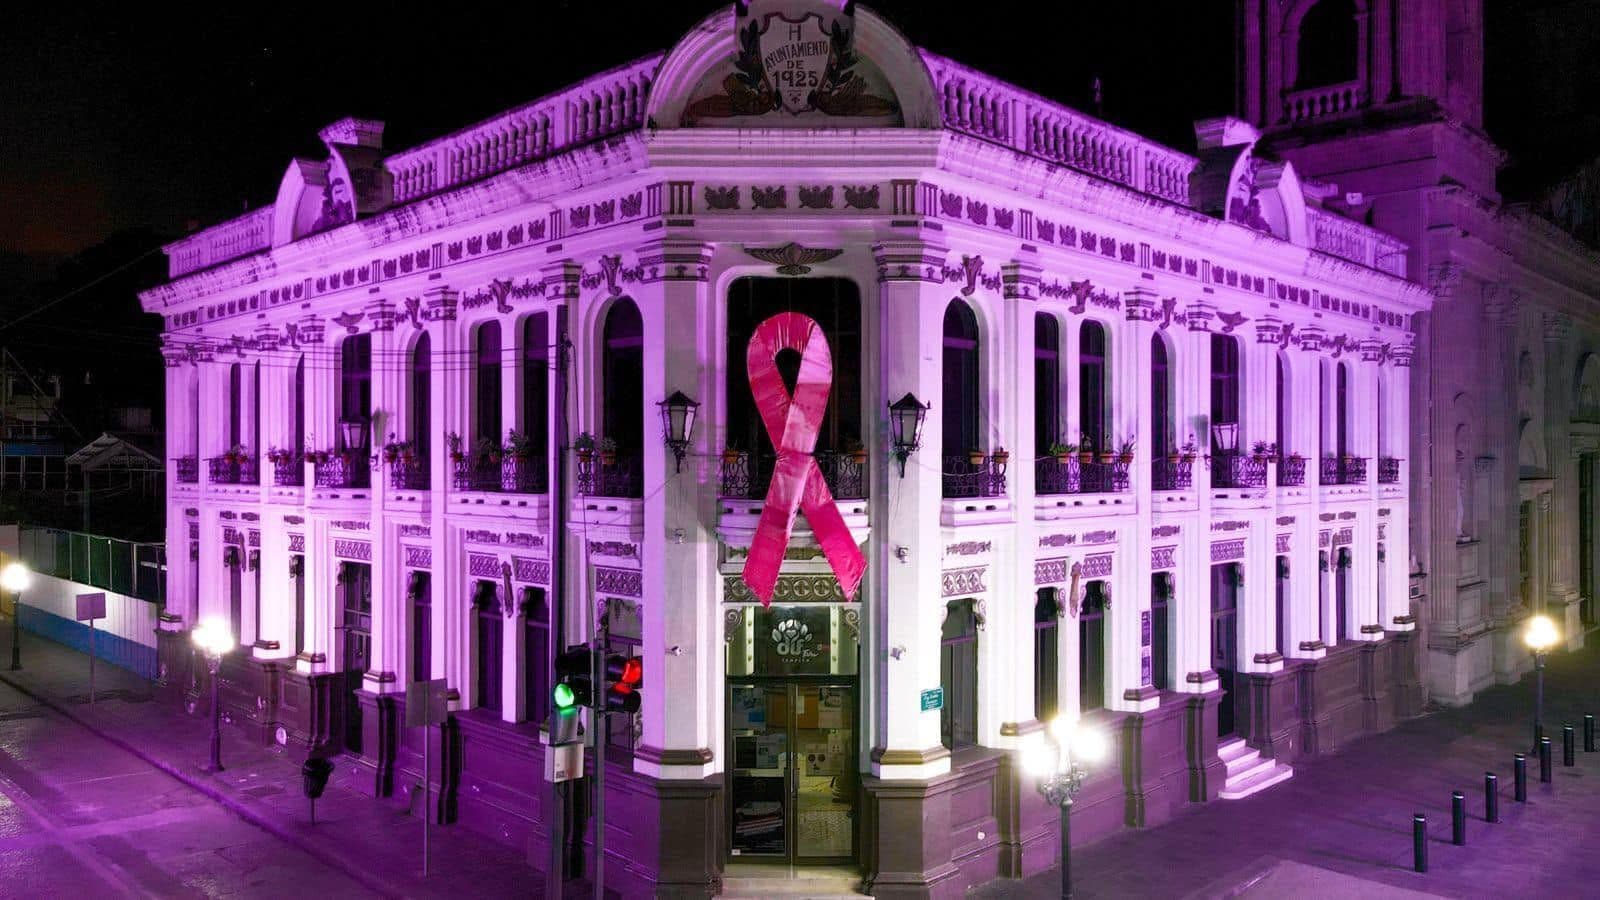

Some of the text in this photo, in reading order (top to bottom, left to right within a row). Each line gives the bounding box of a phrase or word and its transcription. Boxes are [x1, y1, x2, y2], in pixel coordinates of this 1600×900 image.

[789, 24, 801, 41] H
[764, 41, 828, 72] AYUNTAMIENTO
[787, 60, 804, 69] DE
[772, 70, 818, 87] 1925
